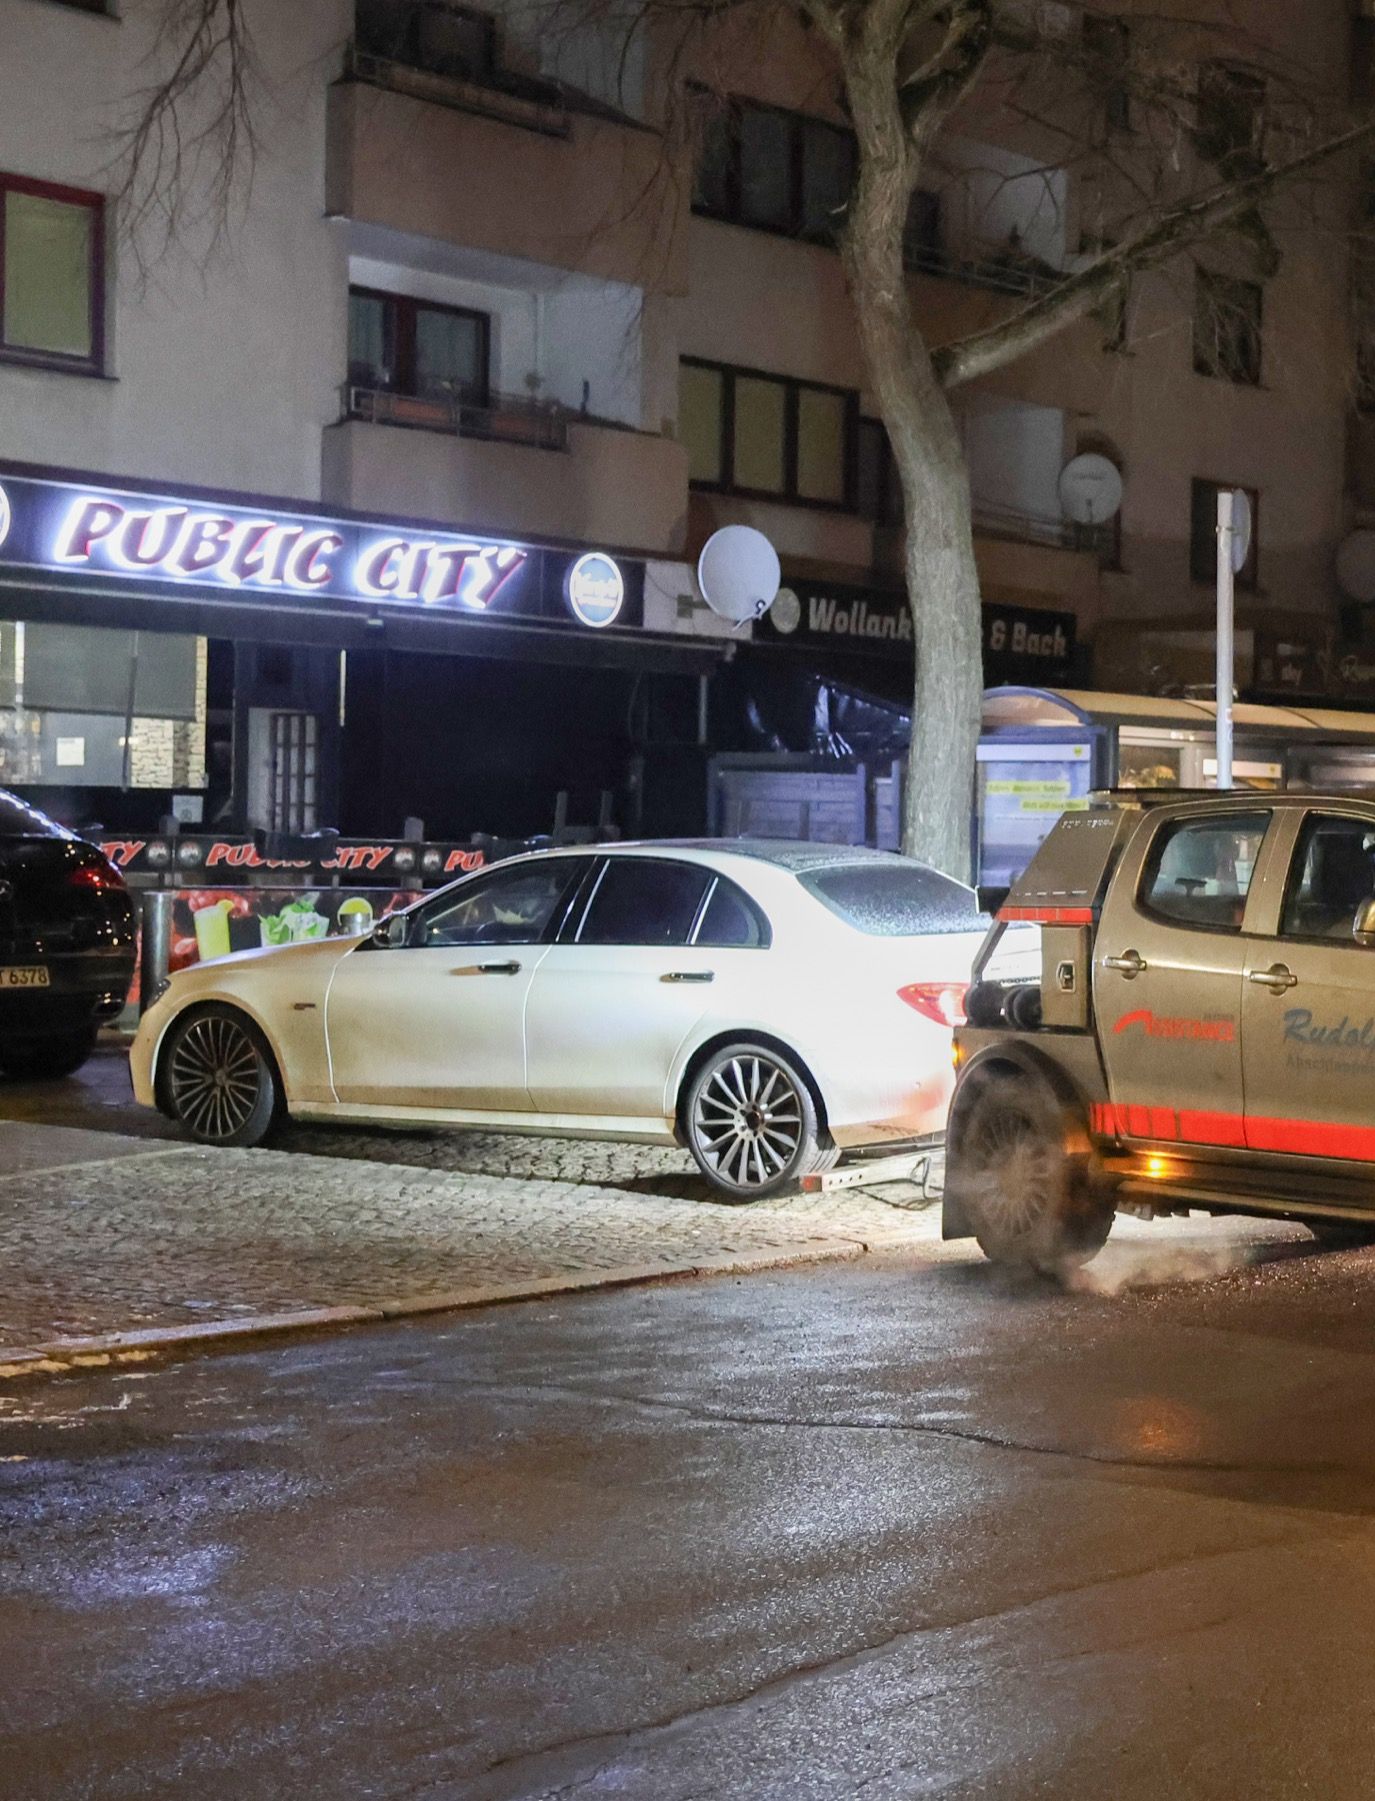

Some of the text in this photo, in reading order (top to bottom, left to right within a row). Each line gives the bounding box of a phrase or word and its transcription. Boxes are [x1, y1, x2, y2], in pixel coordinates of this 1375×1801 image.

[57, 497, 343, 587] PUBLIC
[354, 537, 528, 608] CITY
[9, 969, 48, 985] 6378
